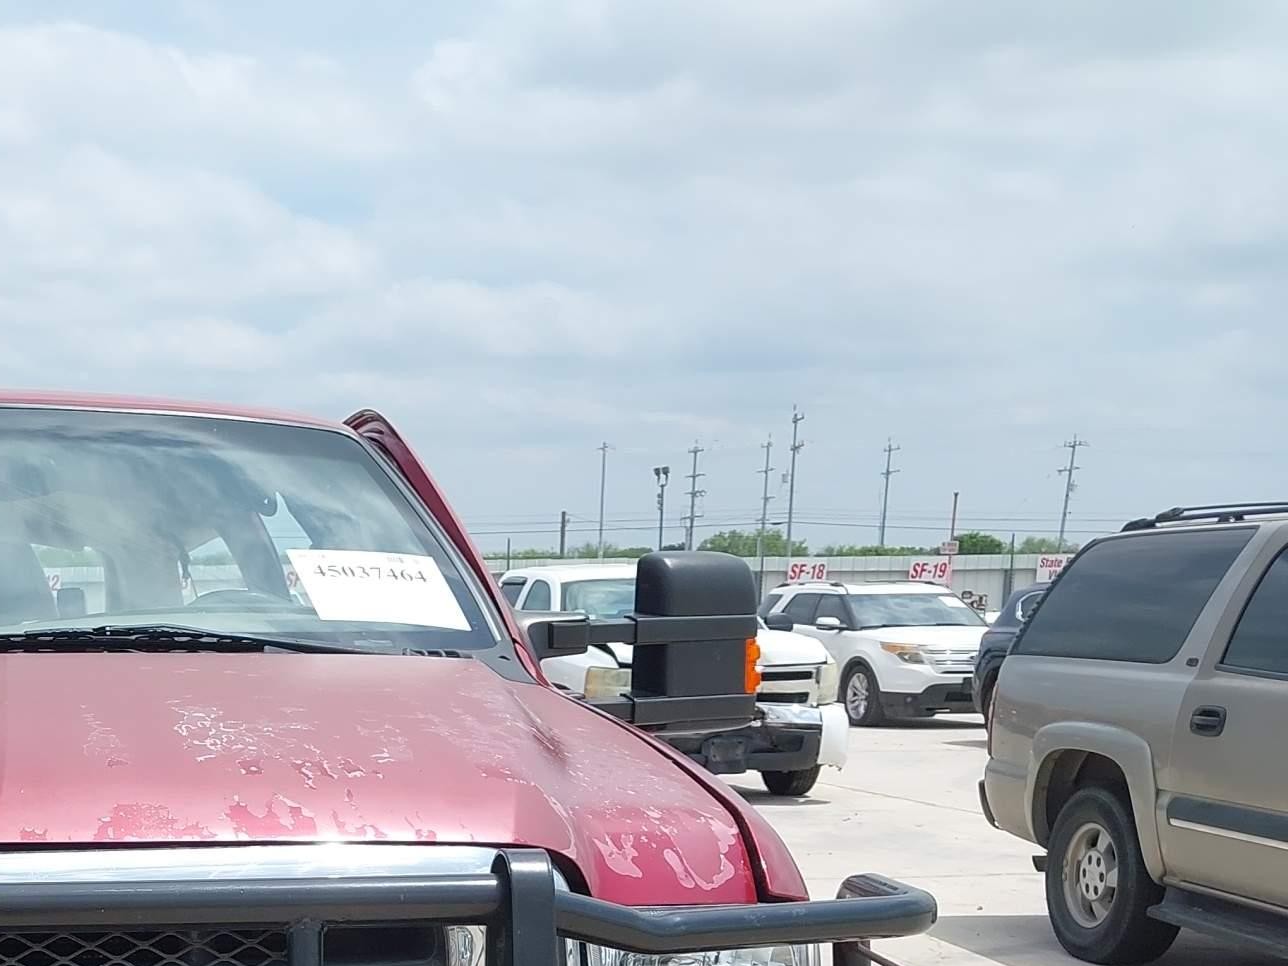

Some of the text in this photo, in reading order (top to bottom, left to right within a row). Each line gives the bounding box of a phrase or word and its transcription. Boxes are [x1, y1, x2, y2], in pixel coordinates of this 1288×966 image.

[910, 562, 947, 579] SF-19
[1040, 557, 1063, 568] State
[314, 565, 427, 582] 45037464
[789, 563, 826, 580] SF-18
